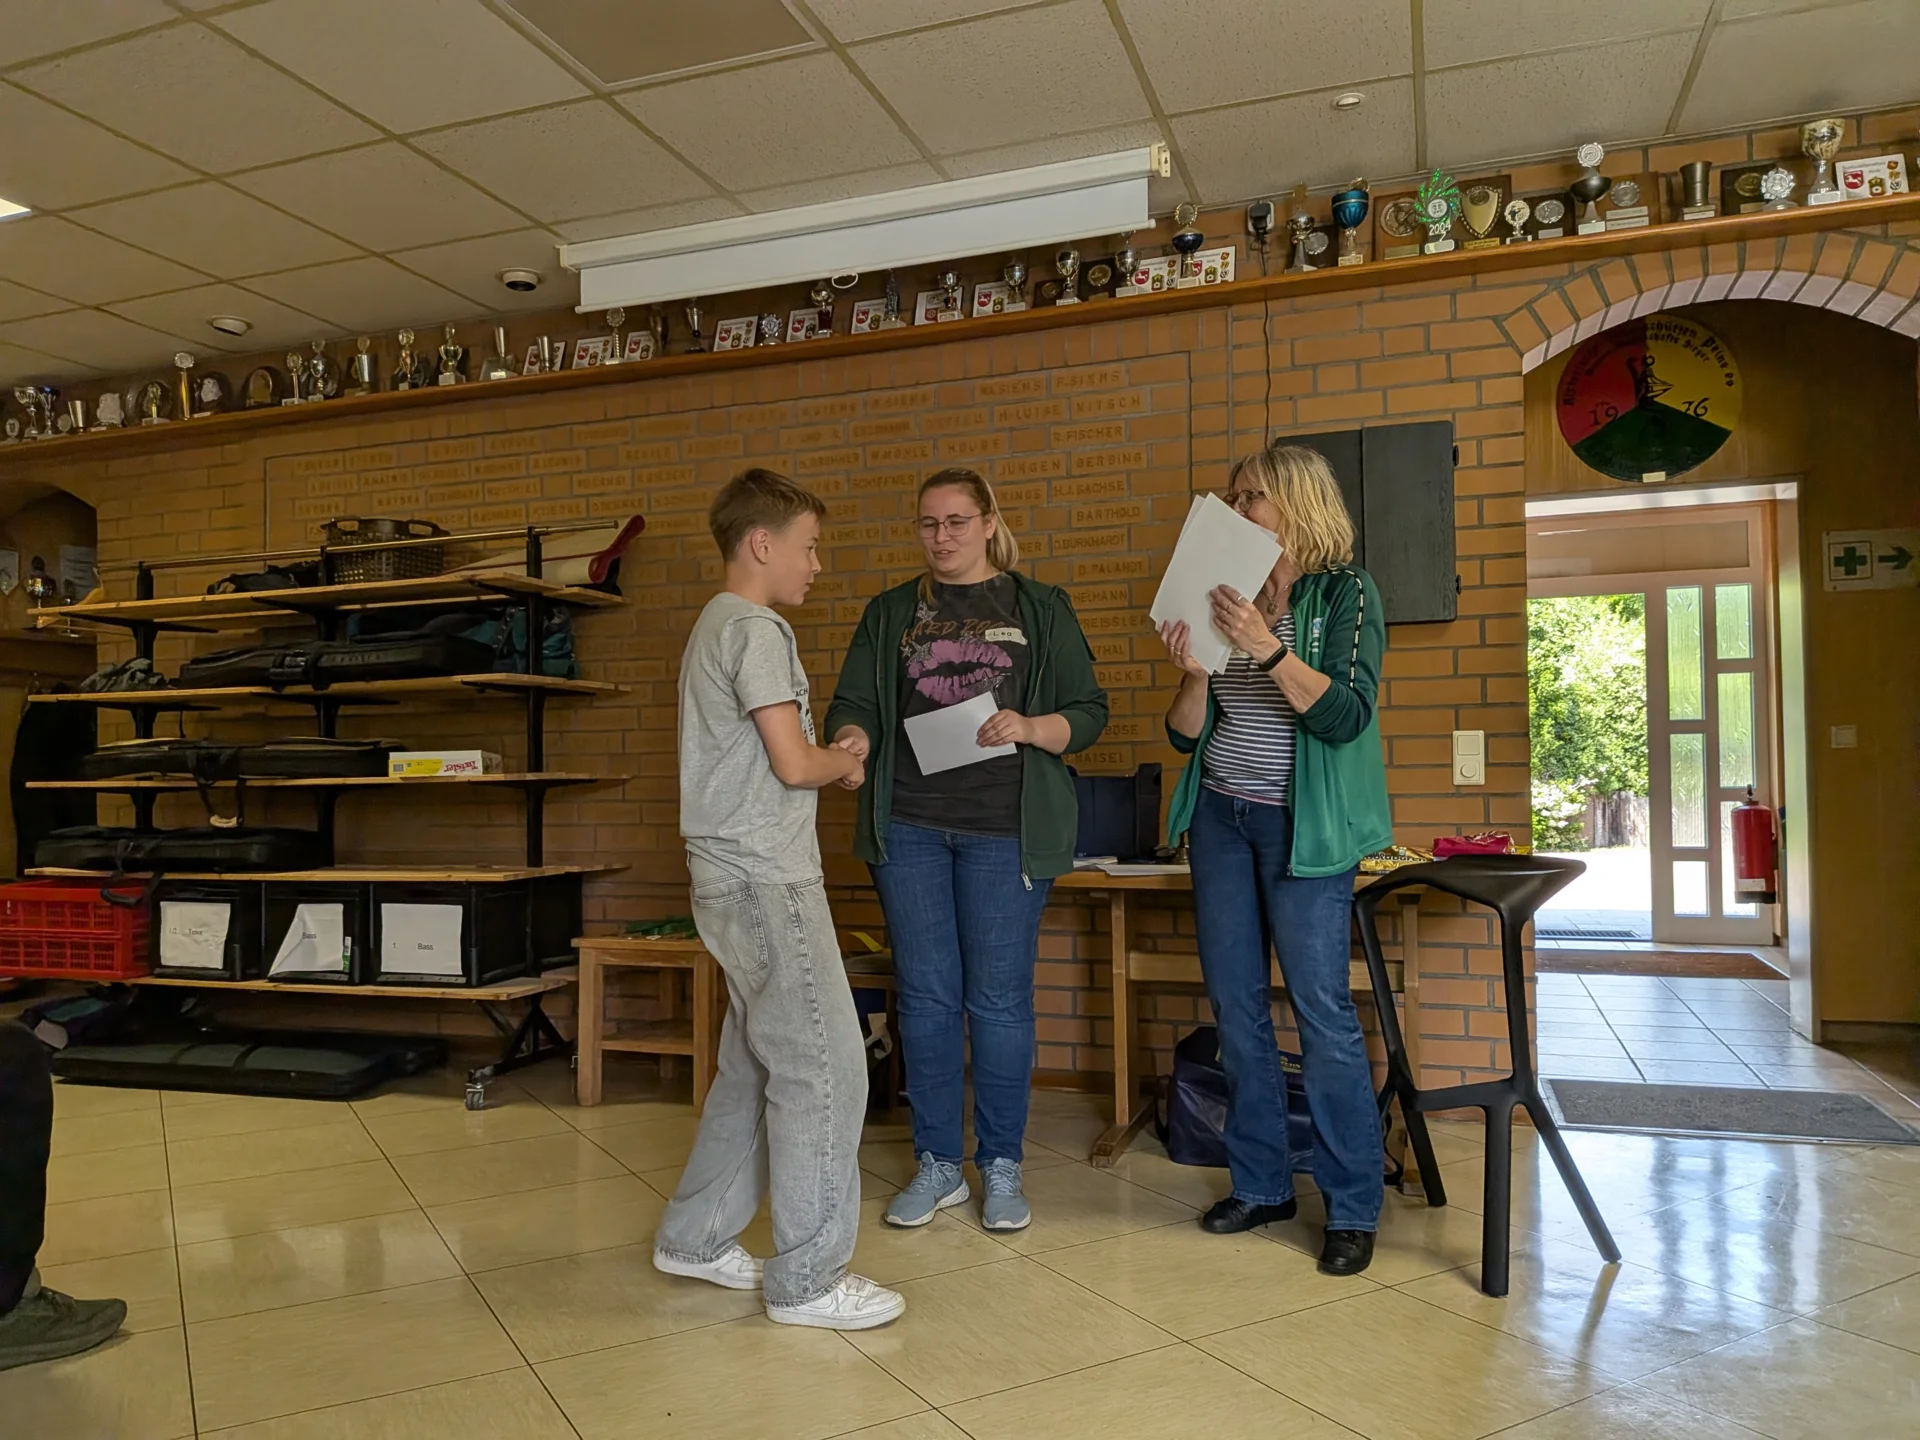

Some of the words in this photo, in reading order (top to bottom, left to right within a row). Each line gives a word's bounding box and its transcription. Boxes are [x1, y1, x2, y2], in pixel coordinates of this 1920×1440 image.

[1075, 394, 1141, 413] NITSCH
[1076, 506, 1140, 522] BARTHOLD
[417, 942, 435, 952] Bass
